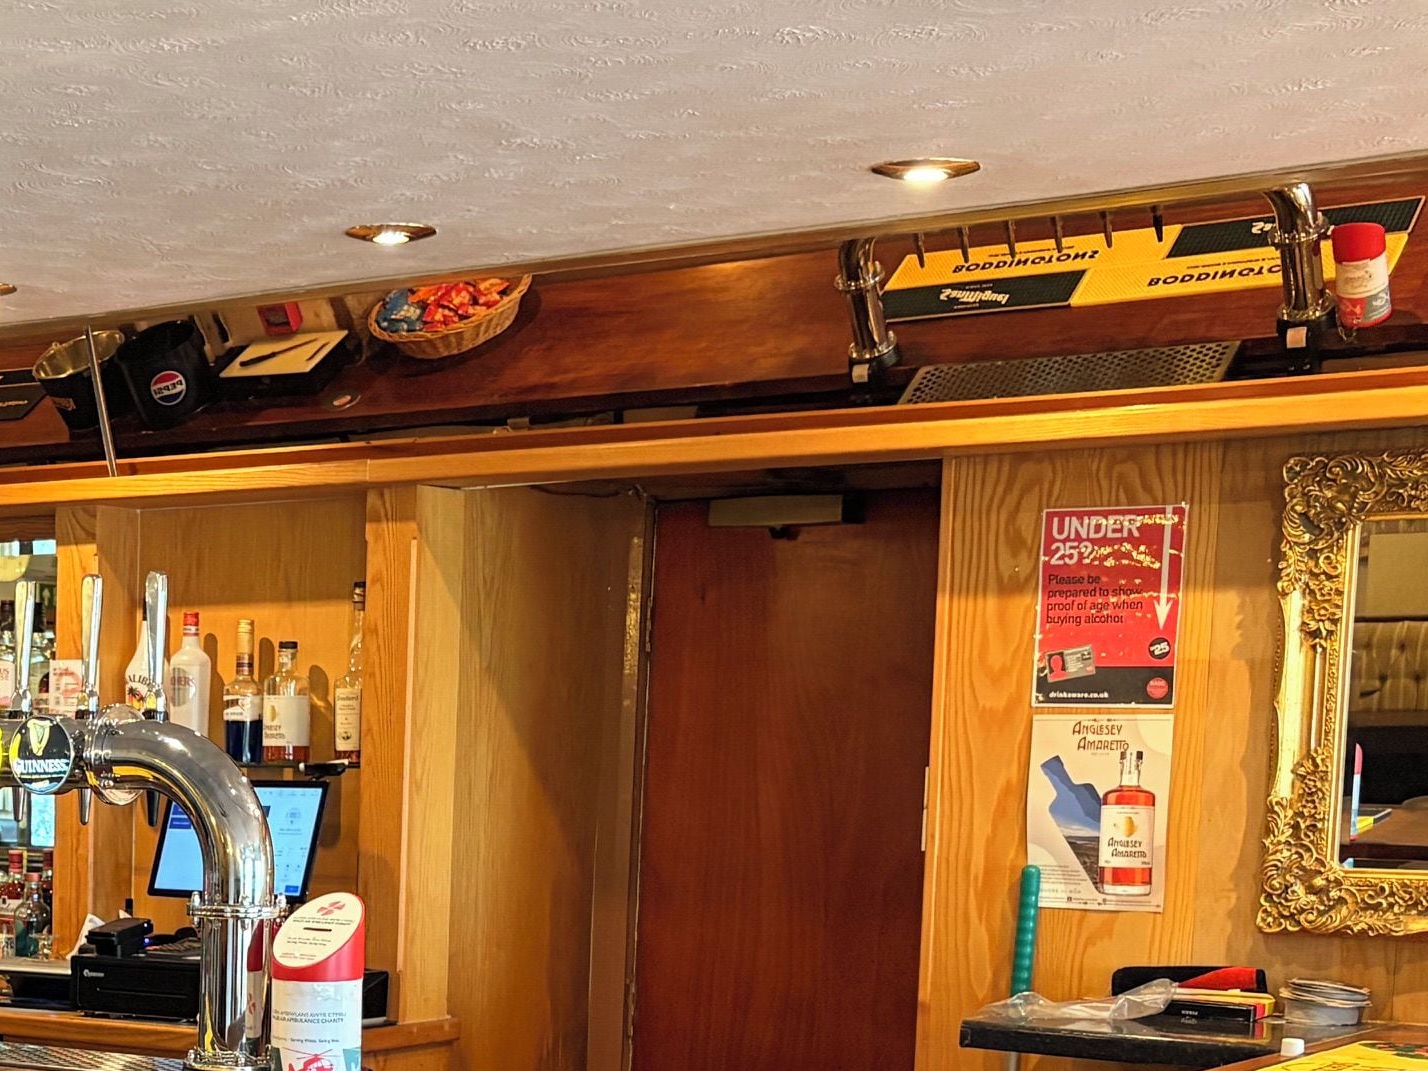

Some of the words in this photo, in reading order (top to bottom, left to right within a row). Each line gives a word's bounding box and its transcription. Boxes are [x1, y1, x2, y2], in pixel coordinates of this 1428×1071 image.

[1051, 514, 1140, 540] UNDER
[1049, 541, 1093, 566] 25?
[1048, 574, 1084, 585] Please
[1087, 574, 1101, 584] be
[1047, 587, 1097, 600] prepared
[1099, 587, 1110, 597] to
[1111, 586, 1143, 597] show
[1046, 600, 1075, 613] proof
[1077, 600, 1088, 611] of
[1089, 602, 1110, 613] age
[1112, 600, 1144, 611] when
[1046, 612, 1082, 627] buying
[1049, 690, 1109, 699] drinkaware.co.uk
[1072, 721, 1123, 736] ANGLESEY
[1077, 736, 1130, 751] AMARETTO
[16, 759, 70, 775] GUINNESS
